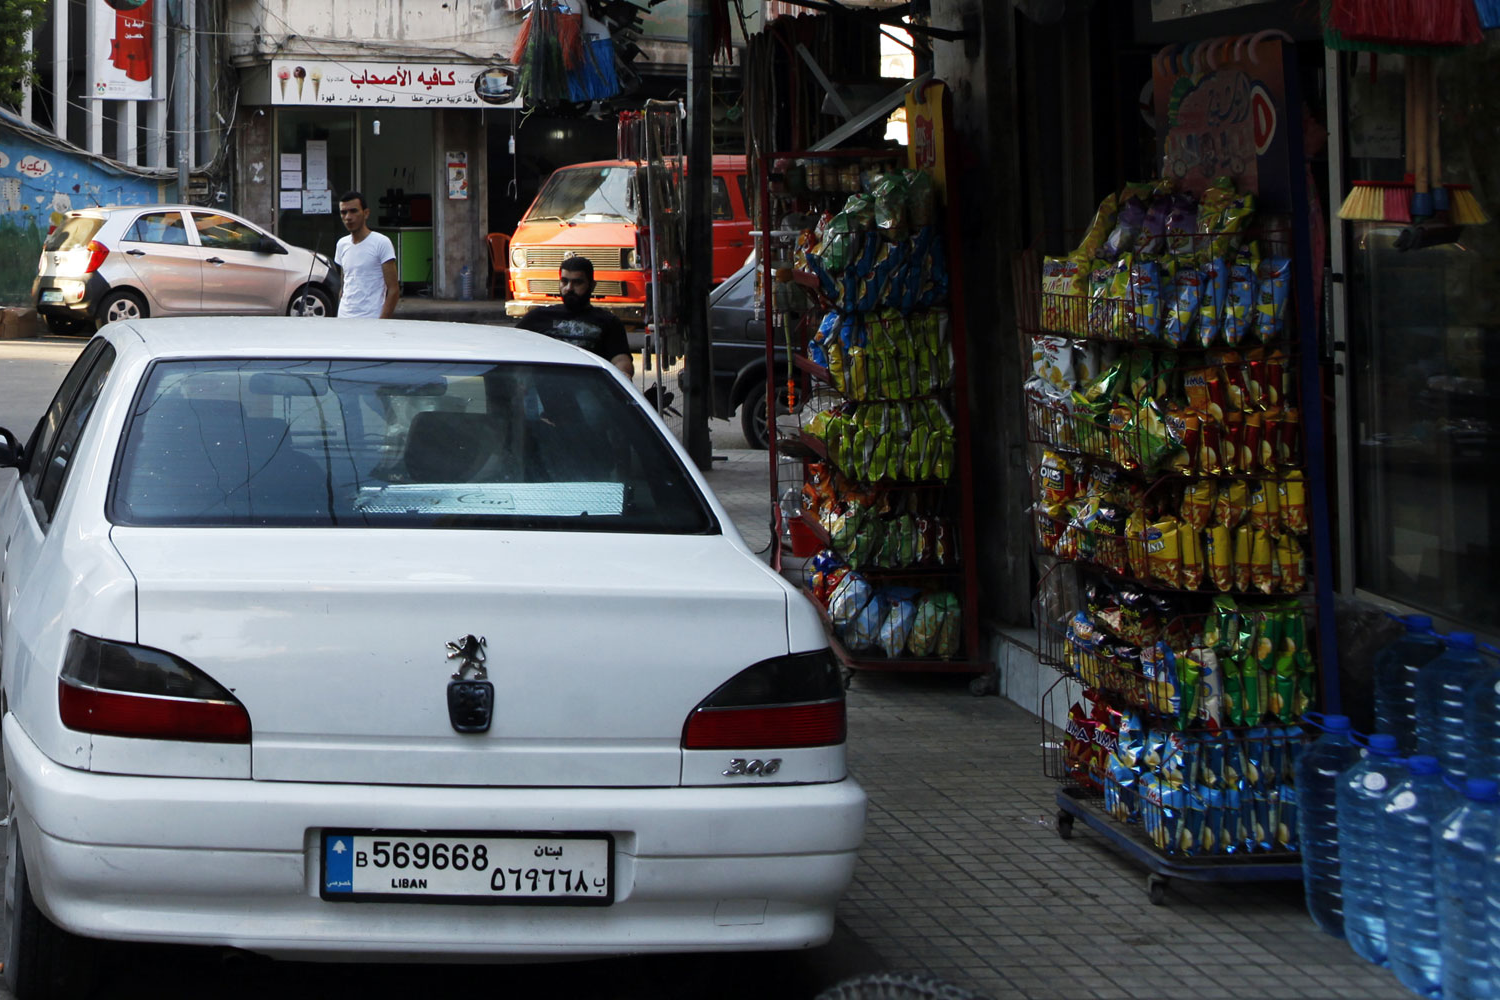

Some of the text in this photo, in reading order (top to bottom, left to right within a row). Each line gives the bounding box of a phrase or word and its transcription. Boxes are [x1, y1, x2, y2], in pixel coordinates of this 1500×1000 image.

[350, 65, 456, 90] كافيه الأصحاب
[321, 93, 335, 103] قهوة
[722, 757, 783, 777] 306
[356, 841, 489, 872] B 569668
[534, 845, 563, 860] لبنان
[391, 878, 428, 890] LIBAN
[490, 867, 588, 893] ٥٦٩٦٦٨
